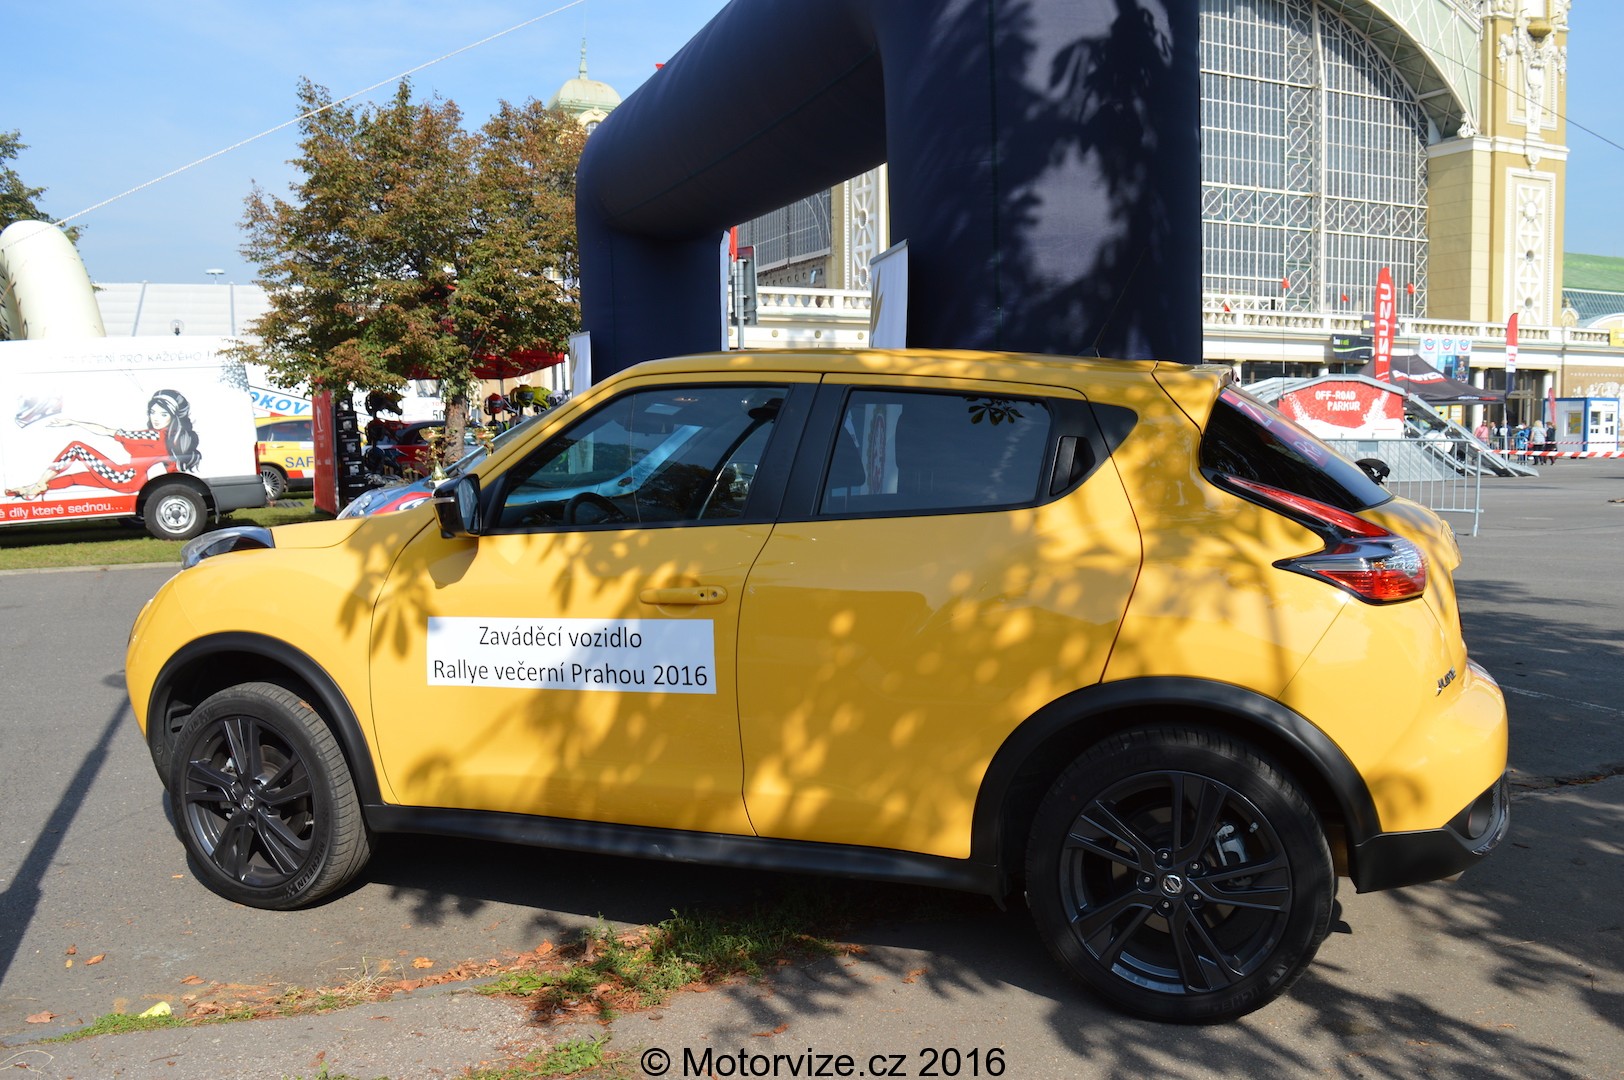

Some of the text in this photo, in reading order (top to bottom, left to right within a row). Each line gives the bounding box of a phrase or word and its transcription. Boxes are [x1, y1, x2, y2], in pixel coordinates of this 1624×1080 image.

[1378, 283, 1392, 362] ISUZU
[1315, 390, 1356, 400] OFF-ROAD
[1327, 401, 1361, 411] PARKUR
[32, 504, 64, 516] které
[479, 625, 643, 648] Zaváděcí vozidlo
[433, 659, 708, 687] Rallye večerní Prahou 2016
